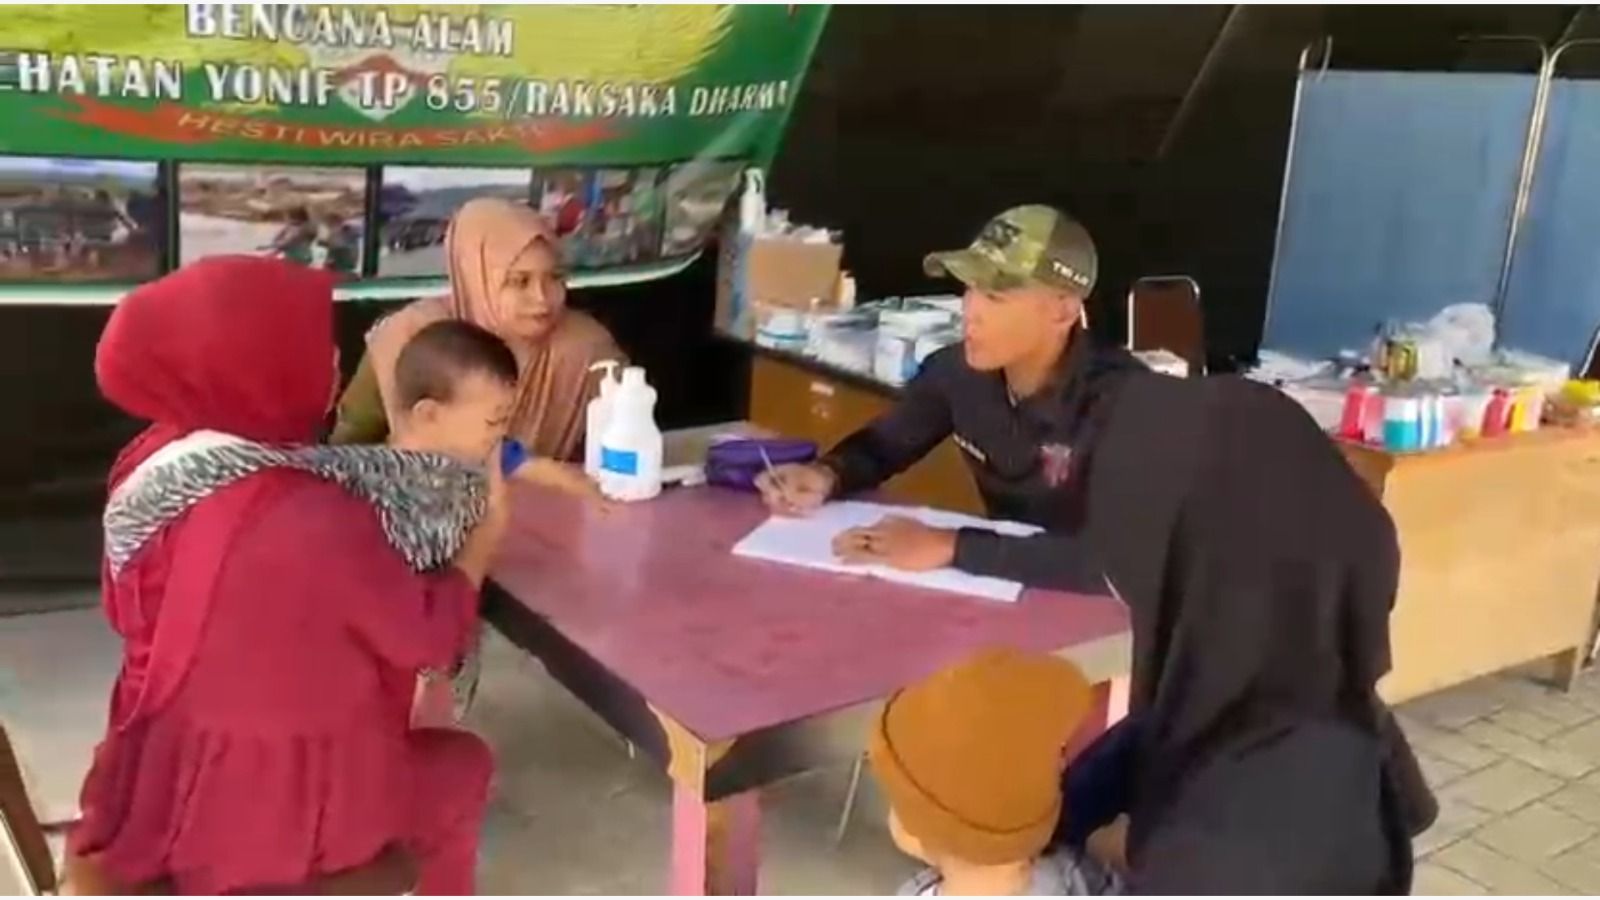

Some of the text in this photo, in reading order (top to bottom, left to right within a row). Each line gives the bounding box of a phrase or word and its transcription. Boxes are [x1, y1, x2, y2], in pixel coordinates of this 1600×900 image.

[188, 4, 514, 55] BENCANA ALAM
[204, 63, 334, 107] YONIF
[357, 71, 408, 109] TP
[426, 74, 675, 118] 855/RAKSAKA
[178, 111, 304, 142] HESTI
[319, 129, 423, 147] WIRA
